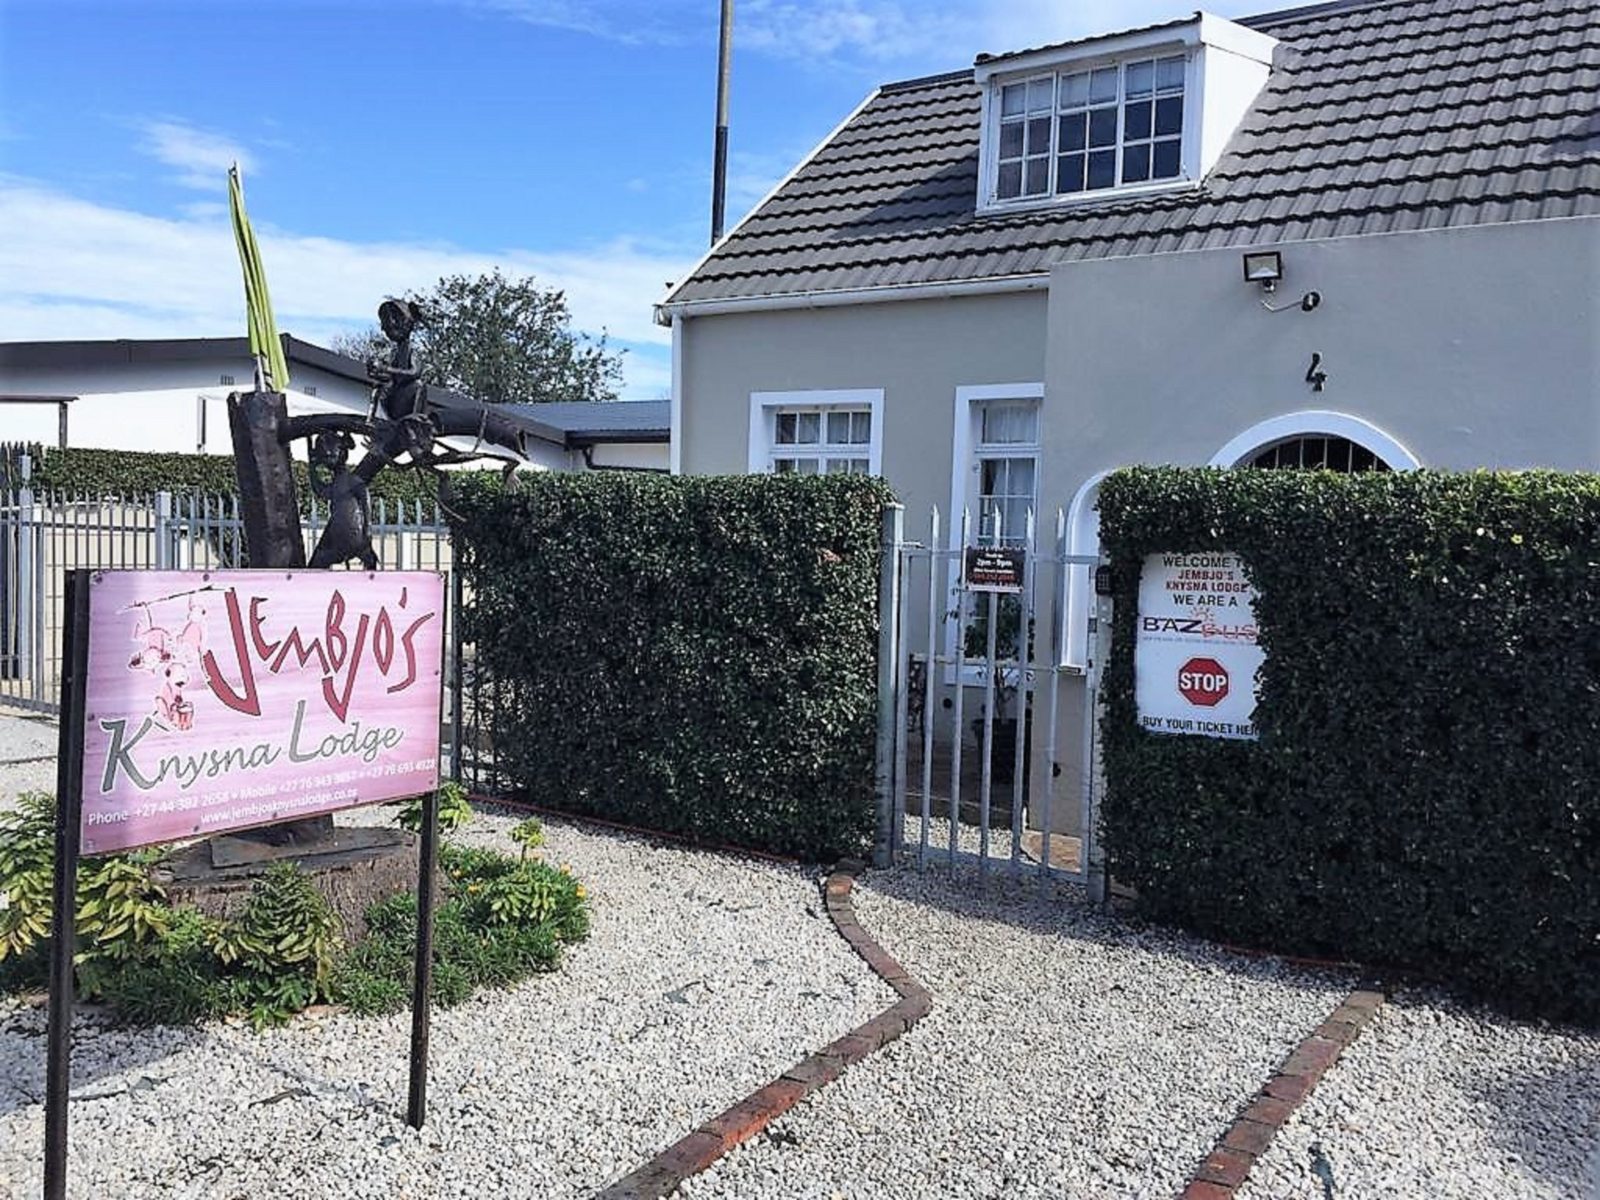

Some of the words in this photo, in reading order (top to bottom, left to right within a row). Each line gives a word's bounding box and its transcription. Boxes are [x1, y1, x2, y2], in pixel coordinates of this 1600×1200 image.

[1305, 352, 1327, 392] 4
[1163, 556, 1230, 568] WELCOME
[1178, 570, 1234, 581] JEMBJO'S
[1166, 581, 1208, 591] KNYSNA
[1211, 582, 1250, 593] LODGE
[1173, 594, 1194, 605] WE
[1197, 594, 1225, 606] ARE
[1228, 596, 1238, 607] A
[202, 586, 435, 724] JEMBJO'S
[1180, 672, 1227, 691] STOP
[1143, 715, 1162, 727] BUY
[1166, 718, 1193, 731] YOUR
[1197, 720, 1233, 734] TICKET
[1236, 724, 1259, 736] HER
[101, 717, 282, 793] Knysna
[289, 700, 403, 763] Lodge
[88, 810, 129, 826] Phone
[240, 784, 277, 800] Mobile
